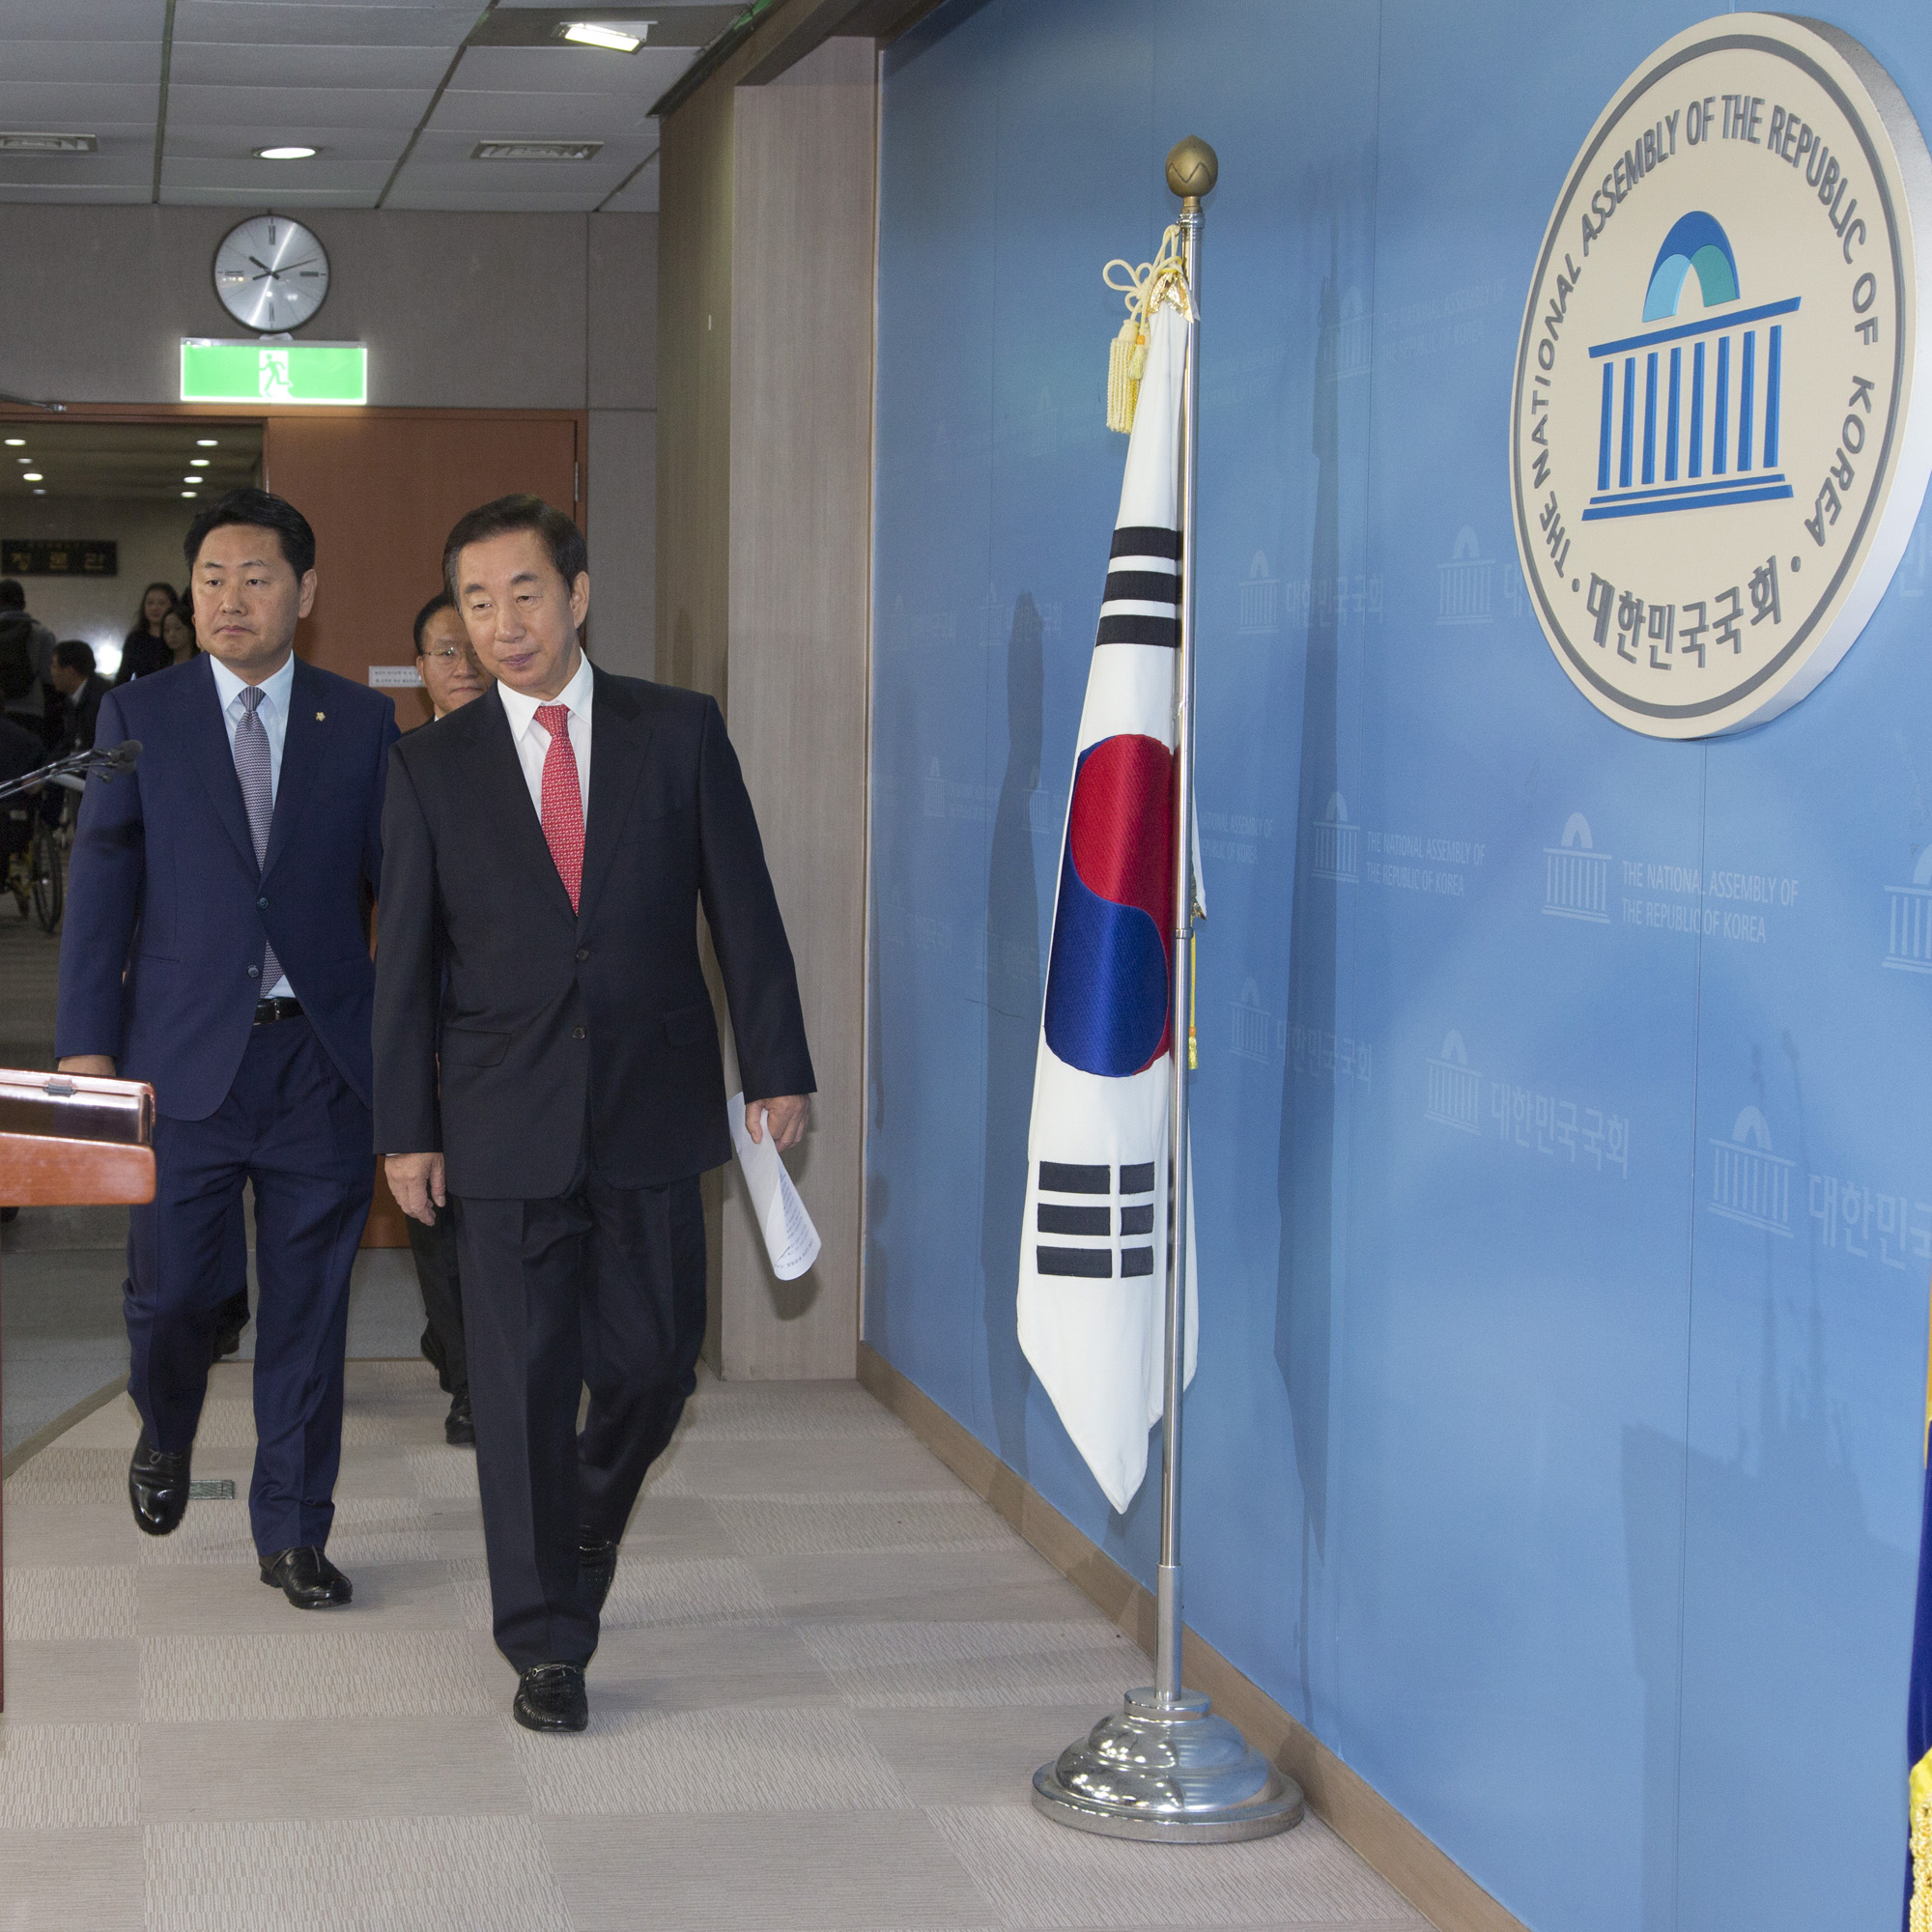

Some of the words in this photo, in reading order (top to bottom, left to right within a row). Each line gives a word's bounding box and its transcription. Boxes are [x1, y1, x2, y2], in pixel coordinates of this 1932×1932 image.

[1687, 97, 1716, 146] OF
[1721, 94, 1766, 144] THE
[1580, 109, 1680, 257] ASSEMBLY
[1767, 104, 1866, 265] REPUBLIC
[1852, 272, 1879, 346] OF
[1531, 253, 1581, 489] NATIONAL
[1804, 375, 1875, 547] KOREA
[1540, 491, 1571, 578] THE
[1586, 554, 1781, 670] 대한민국국회
[1367, 831, 1381, 852] THE
[1383, 833, 1424, 859] NATIONAL
[1426, 838, 1470, 864] ASSEMBLY
[1472, 842, 1486, 866] OF
[1623, 861, 1643, 887] THE
[1647, 864, 1705, 895] NATIONAL
[1709, 870, 1776, 904] ASSEMBLY
[1780, 878, 1799, 906] OF
[1622, 898, 1642, 925] THE
[1646, 901, 1701, 934] REPUBLIC
[1703, 909, 1720, 935] OF
[1723, 912, 1767, 943] KOREA
[1491, 1081, 1629, 1180] 대한민국국회
